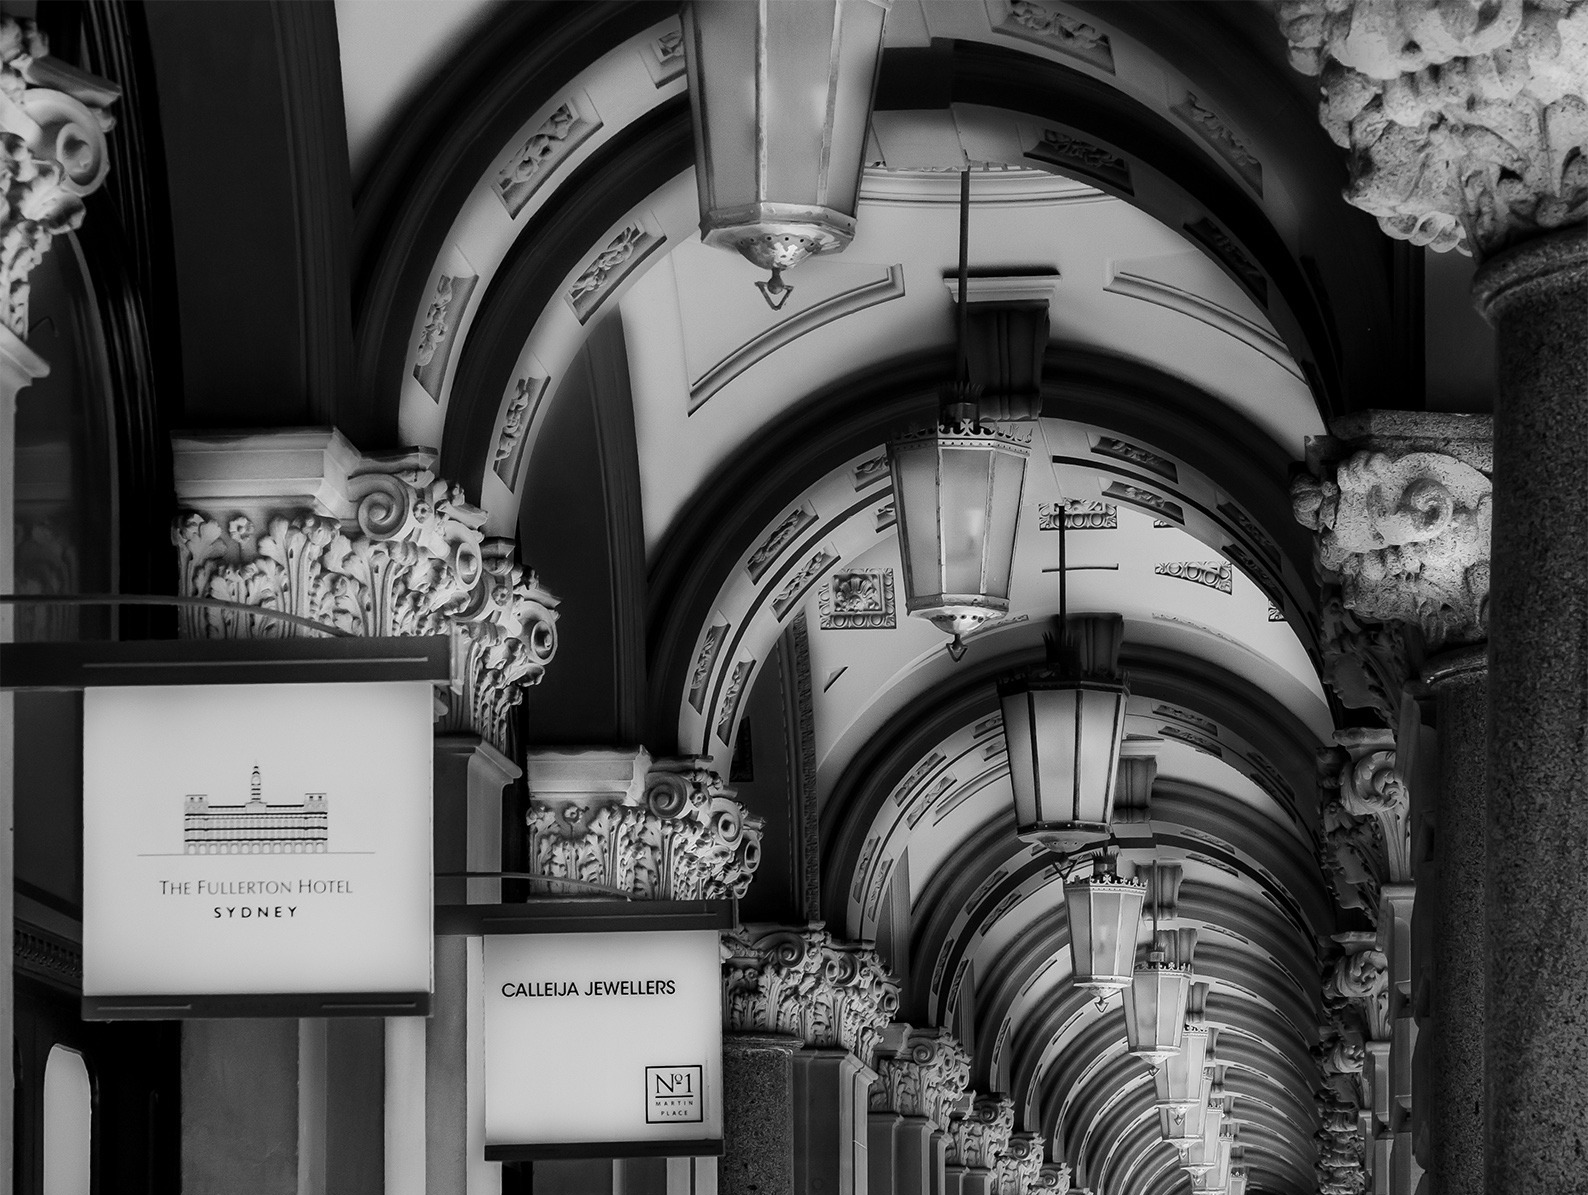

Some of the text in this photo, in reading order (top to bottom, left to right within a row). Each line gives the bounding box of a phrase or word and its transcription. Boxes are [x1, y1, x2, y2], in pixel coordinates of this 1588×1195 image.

[198, 880, 292, 895] FULLERTON
[299, 879, 353, 894] HOTEL
[214, 906, 298, 919] SYDNEY
[501, 980, 676, 997] CALLEIJA JEWELLERS
